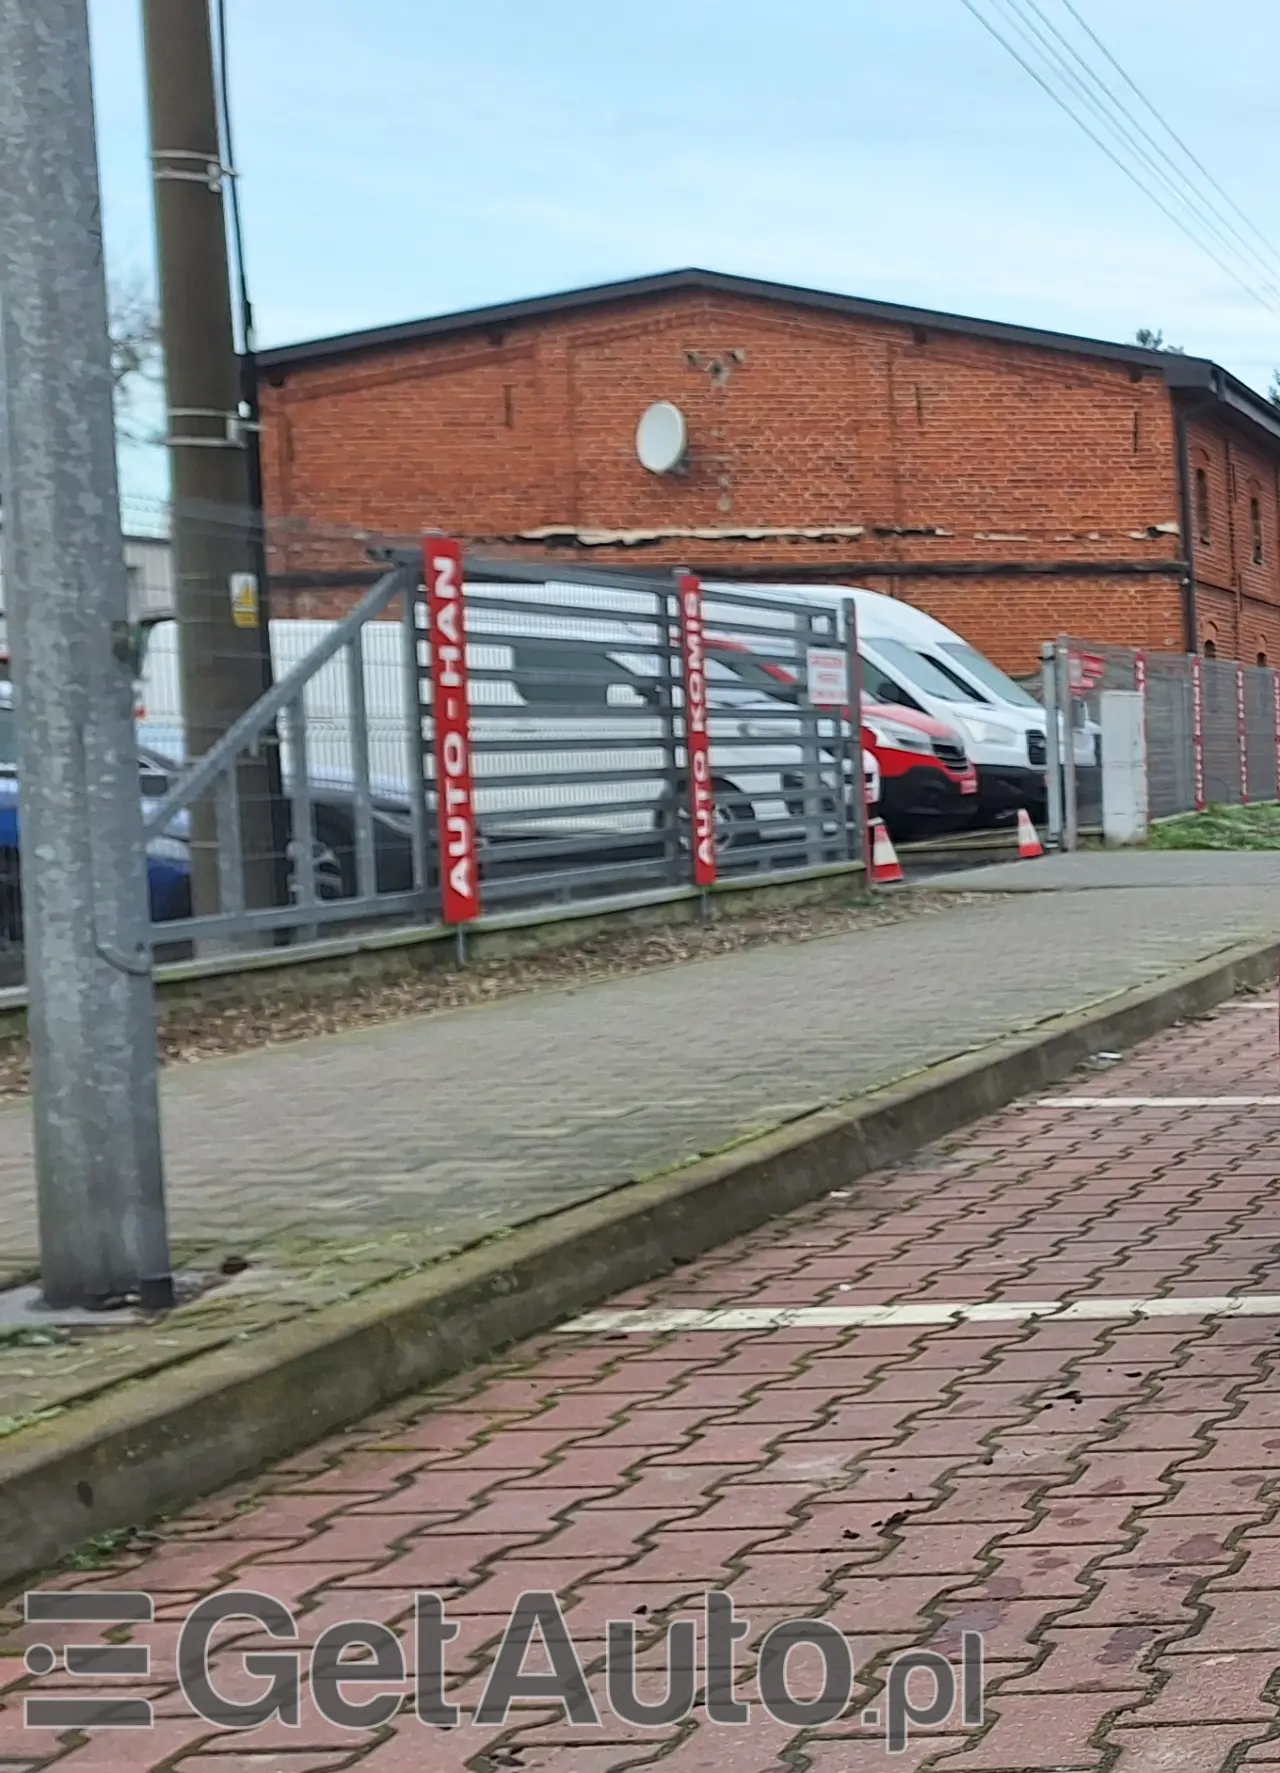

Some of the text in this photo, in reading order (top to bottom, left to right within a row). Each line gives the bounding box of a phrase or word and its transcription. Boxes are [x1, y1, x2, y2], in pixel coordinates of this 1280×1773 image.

[433, 556, 472, 899] AUTO-HAN
[684, 591, 714, 866] AUTO KOMIS
